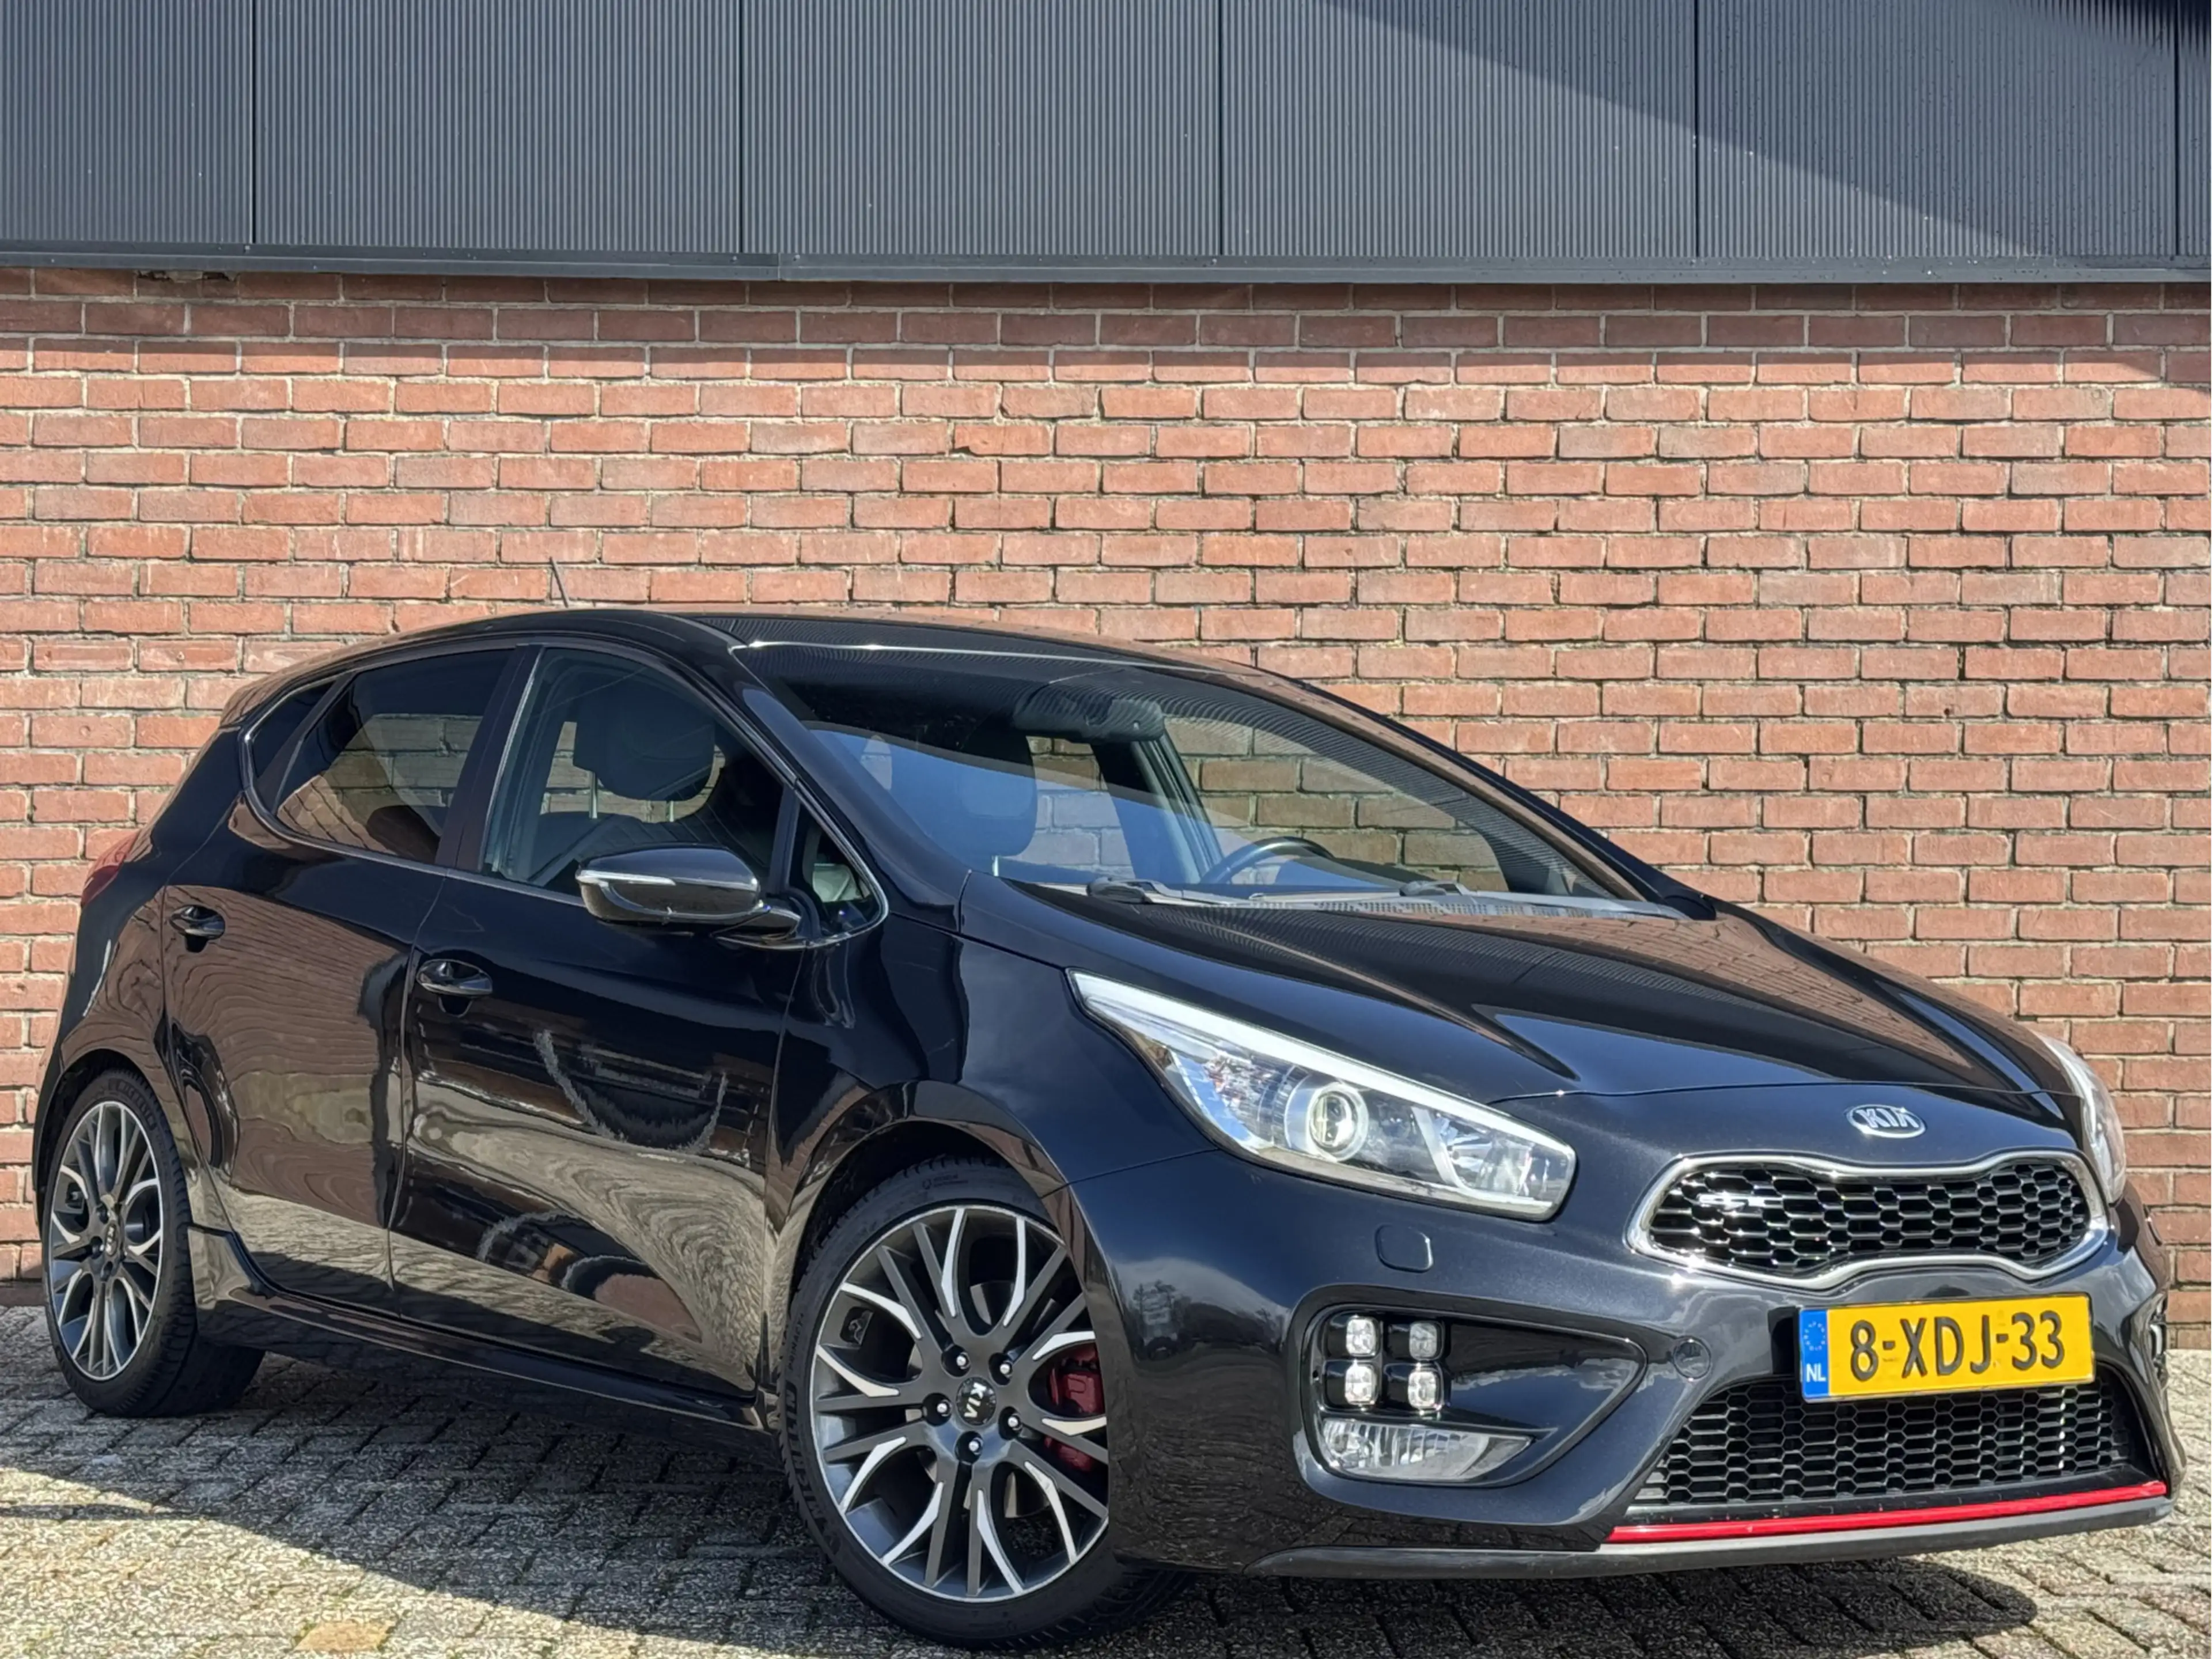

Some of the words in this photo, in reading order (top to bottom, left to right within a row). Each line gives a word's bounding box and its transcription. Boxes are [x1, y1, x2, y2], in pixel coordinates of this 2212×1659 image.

[1855, 1107, 1920, 1128] KIA
[1850, 1310, 2065, 1381] 8-XDJ-33
[1806, 1363, 1826, 1382] NL
[964, 1382, 987, 1418] KIA
